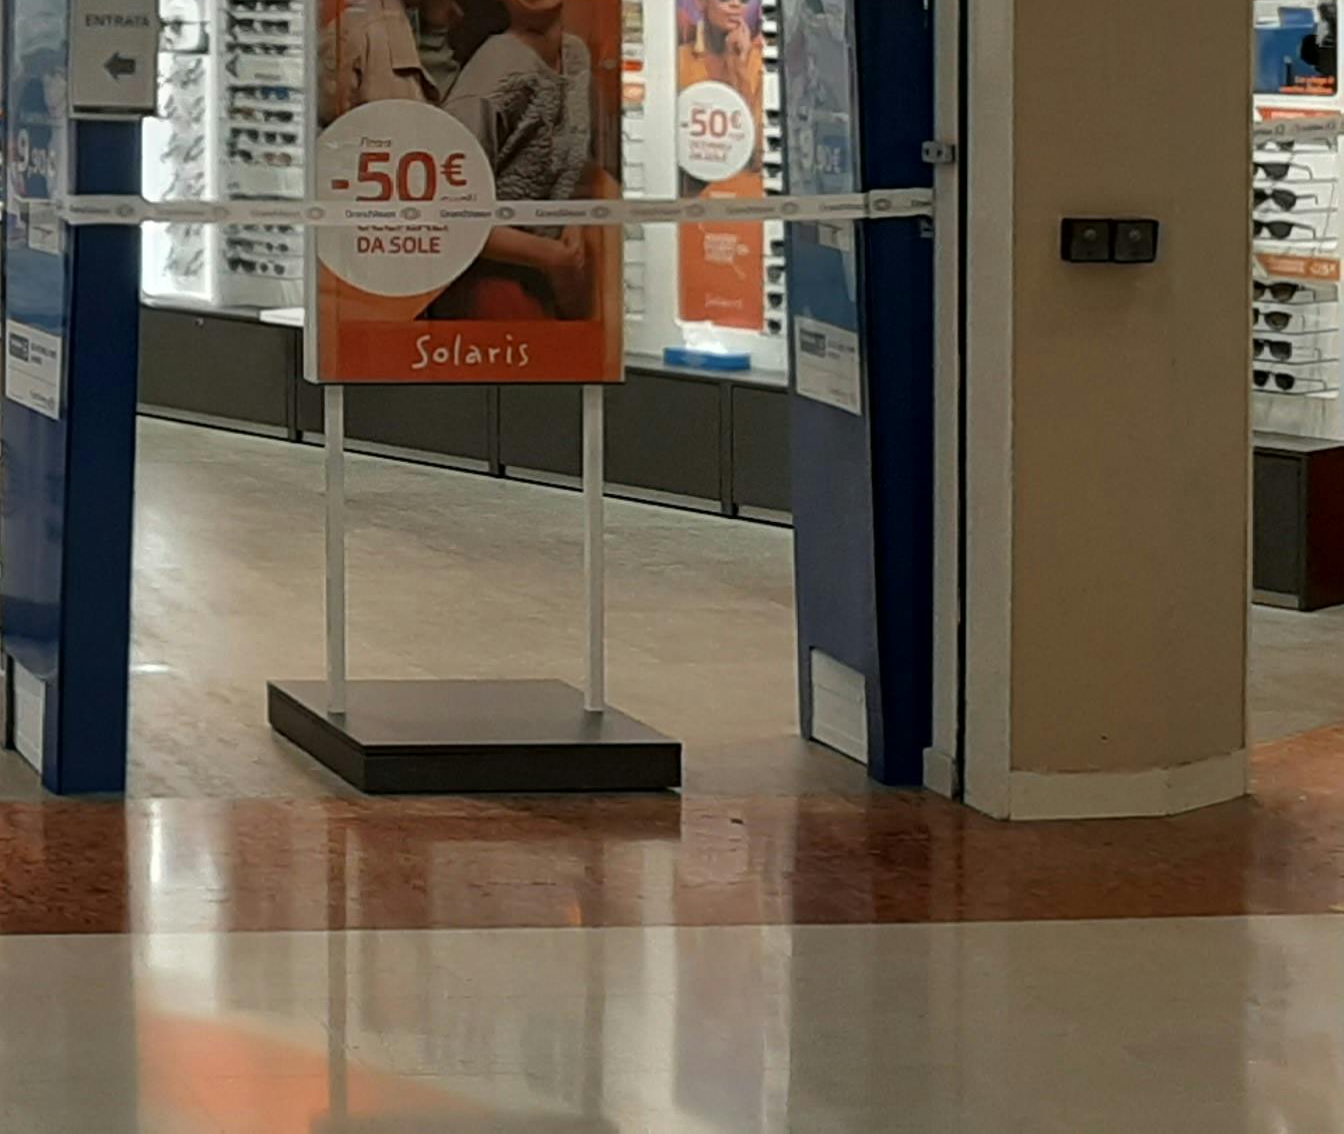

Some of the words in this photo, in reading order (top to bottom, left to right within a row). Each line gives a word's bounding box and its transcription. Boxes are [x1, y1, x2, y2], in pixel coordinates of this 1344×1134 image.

[86, 14, 150, 28] ENTRATA
[331, 151, 468, 202] -50€
[357, 236, 384, 254] DA
[388, 236, 440, 254] SOLE
[412, 334, 529, 369] Solaris
